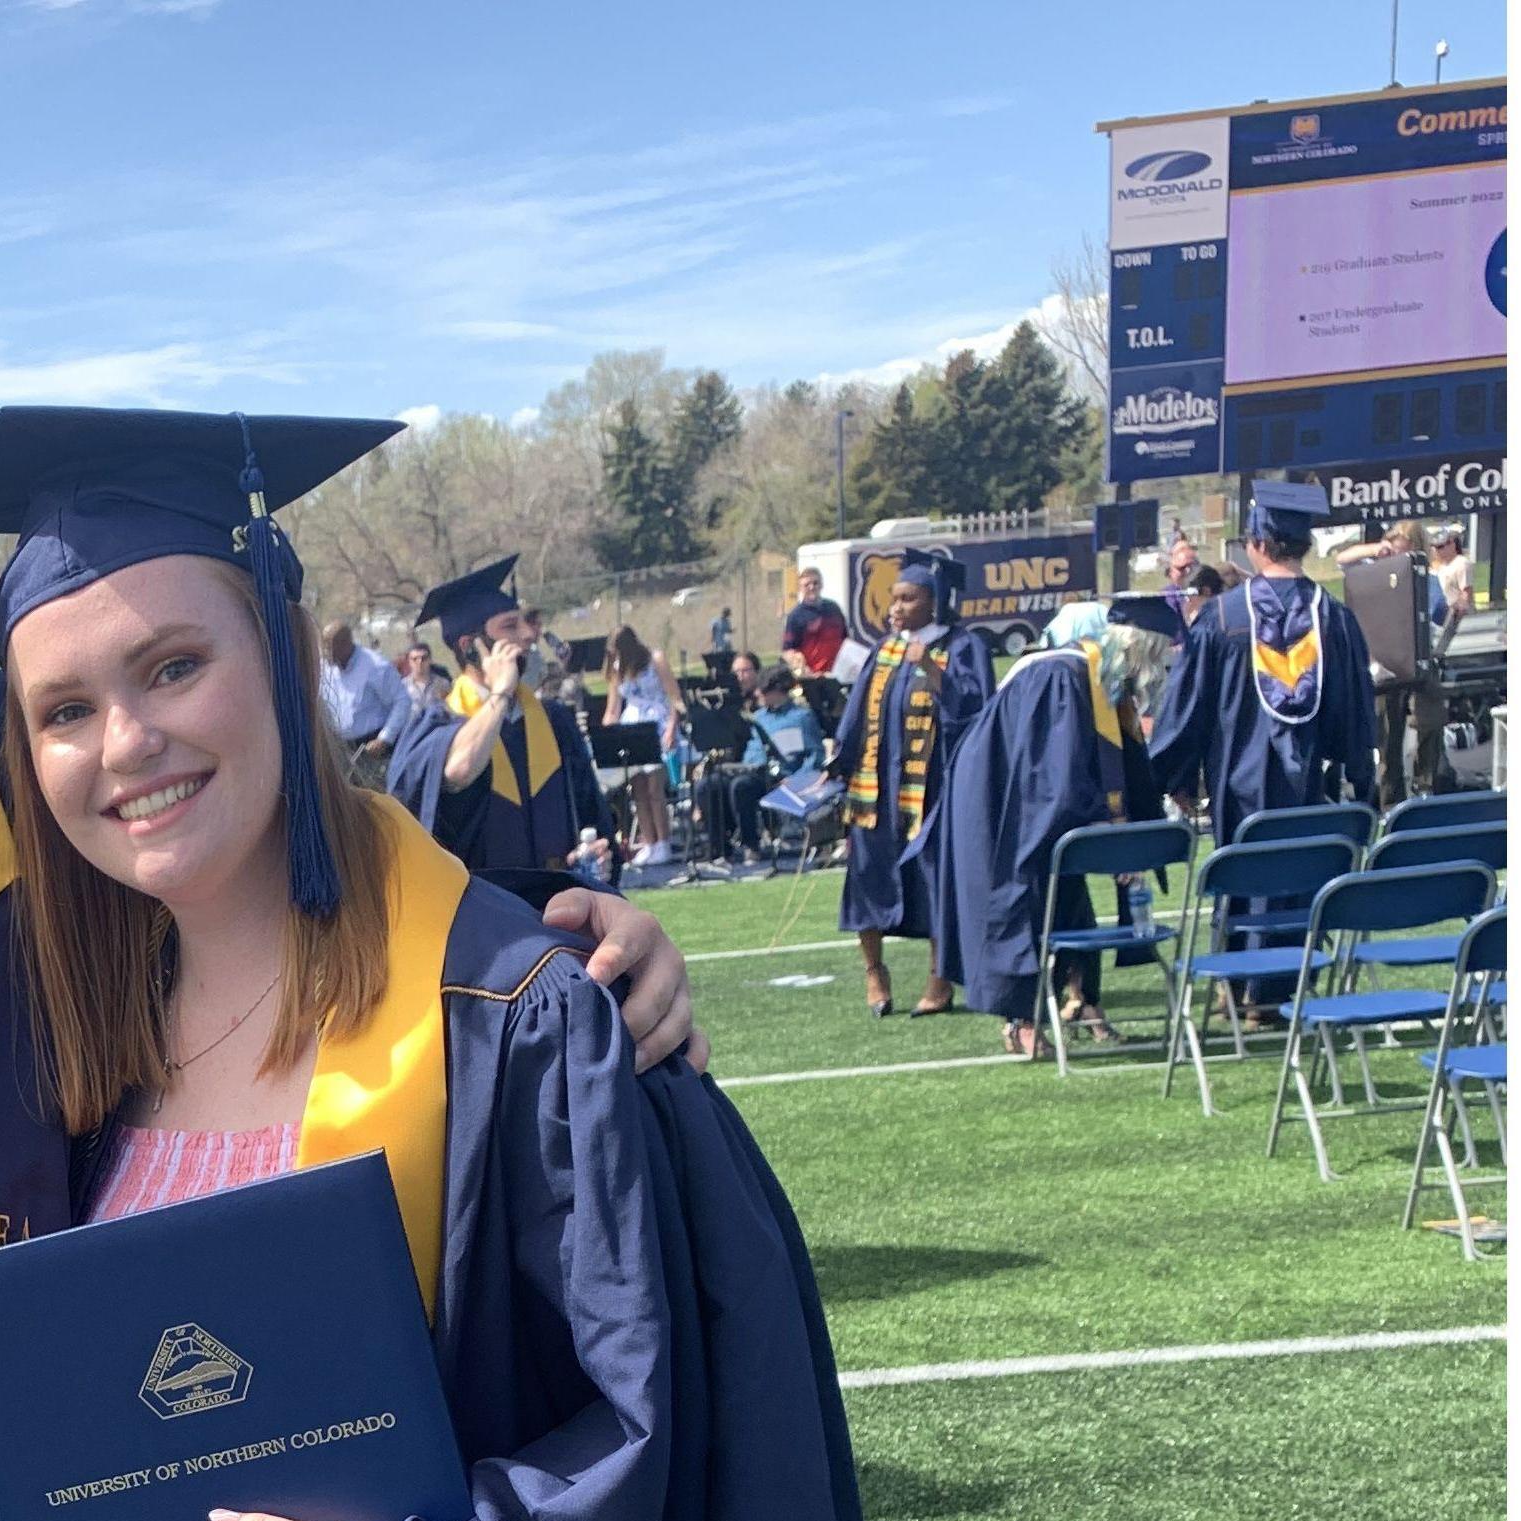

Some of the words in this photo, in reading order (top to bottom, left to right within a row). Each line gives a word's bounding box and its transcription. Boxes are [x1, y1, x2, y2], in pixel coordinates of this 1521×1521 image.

[1409, 195, 1468, 210] Summer
[1114, 252, 1152, 268] DOWN
[1181, 246, 1197, 261] TO
[1198, 244, 1218, 259] GO
[1334, 256, 1390, 271] Graduate
[1391, 250, 1444, 265] Students
[1335, 301, 1424, 319] Undergraduate
[1126, 326, 1174, 349] T.O.L.
[1309, 323, 1360, 338] Students
[1124, 391, 1205, 424] Modelo
[1331, 468, 1410, 507] Bank
[1415, 463, 1451, 498] of
[1361, 500, 1449, 519] THERE'S
[984, 557, 1070, 591] UNC
[192, 1329, 243, 1370] NORTHERN
[145, 1335, 174, 1391] UNIVERSITY
[173, 1393, 230, 1413] COLORADO
[45, 1469, 152, 1506] UNIVERSITY
[155, 1463, 180, 1481] OF
[184, 1438, 287, 1475] NORTHERN
[290, 1412, 396, 1450] COLORADO
